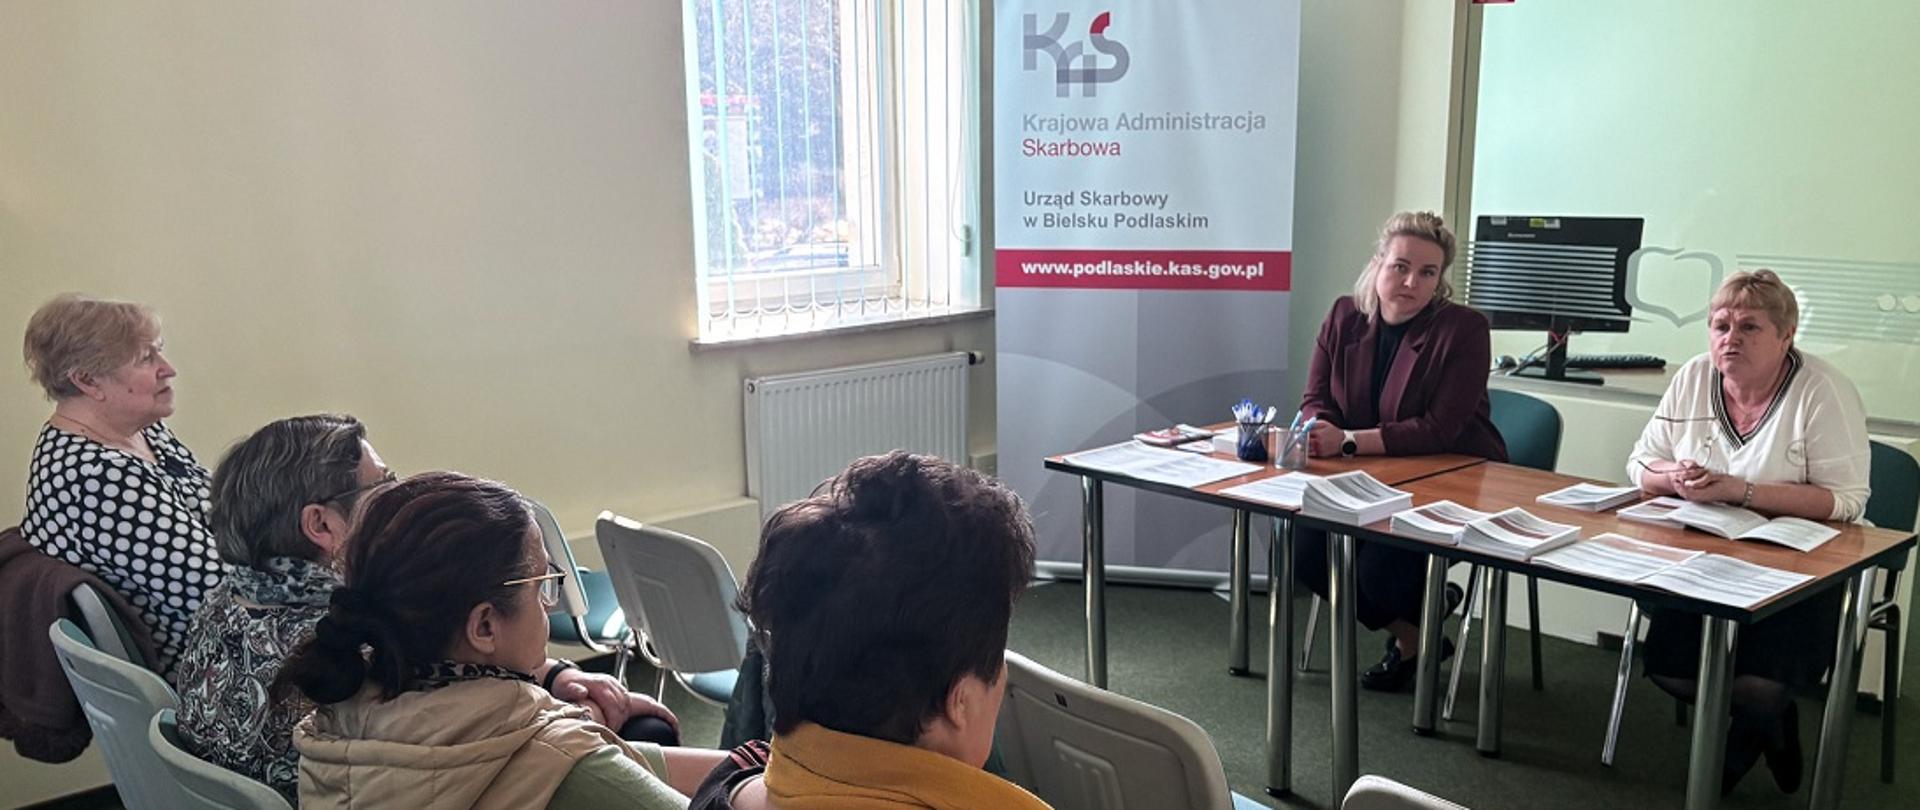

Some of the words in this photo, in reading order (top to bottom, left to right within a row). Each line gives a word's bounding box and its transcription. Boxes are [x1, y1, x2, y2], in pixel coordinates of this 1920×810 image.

[1023, 113, 1109, 134] Krajowa
[1116, 111, 1266, 132] Administracja
[1022, 139, 1121, 157] Skarbowa
[1024, 191, 1074, 209] Urząd
[1080, 190, 1168, 209] Skarbowy
[1024, 216, 1037, 228] w
[1043, 213, 1108, 228] Bielsku
[1114, 213, 1209, 229] Podlaskim
[1021, 260, 1264, 278] www.podlaskie.kas.gov.pl
